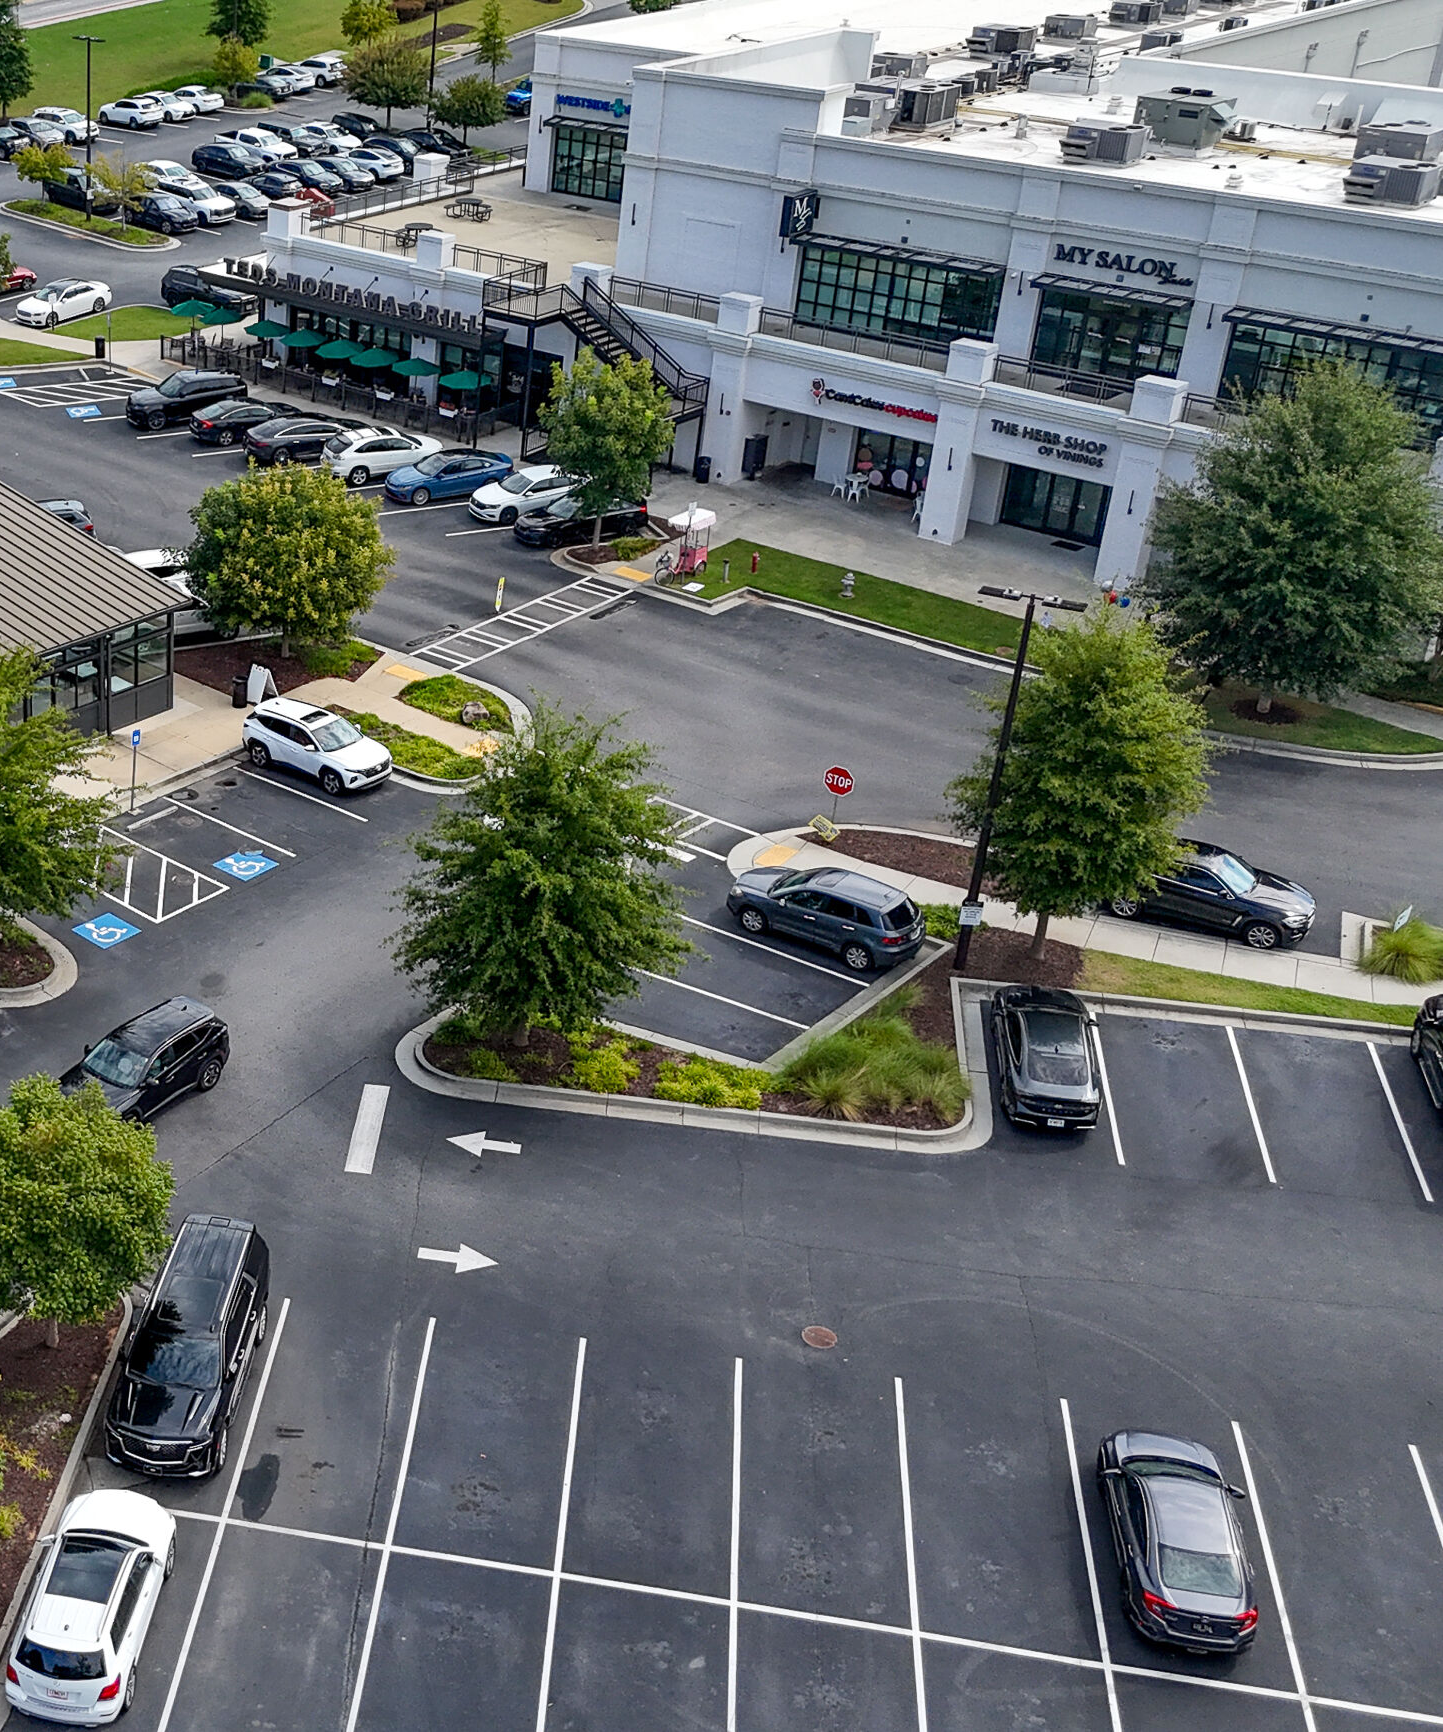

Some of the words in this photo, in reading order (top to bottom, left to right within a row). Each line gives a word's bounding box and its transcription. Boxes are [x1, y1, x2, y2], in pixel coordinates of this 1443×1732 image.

[557, 94, 611, 112] WESTSIDE
[1053, 243, 1095, 265] MY
[1095, 250, 1177, 279] SALON
[287, 272, 401, 316] MONTANA
[408, 301, 482, 335] GRILL
[991, 419, 1019, 436] THE
[1022, 426, 1061, 446] HERB
[1064, 436, 1107, 456] SHOP
[1038, 446, 1054, 456] OF
[1056, 449, 1104, 468] VININGS
[826, 773, 852, 789] STOP
